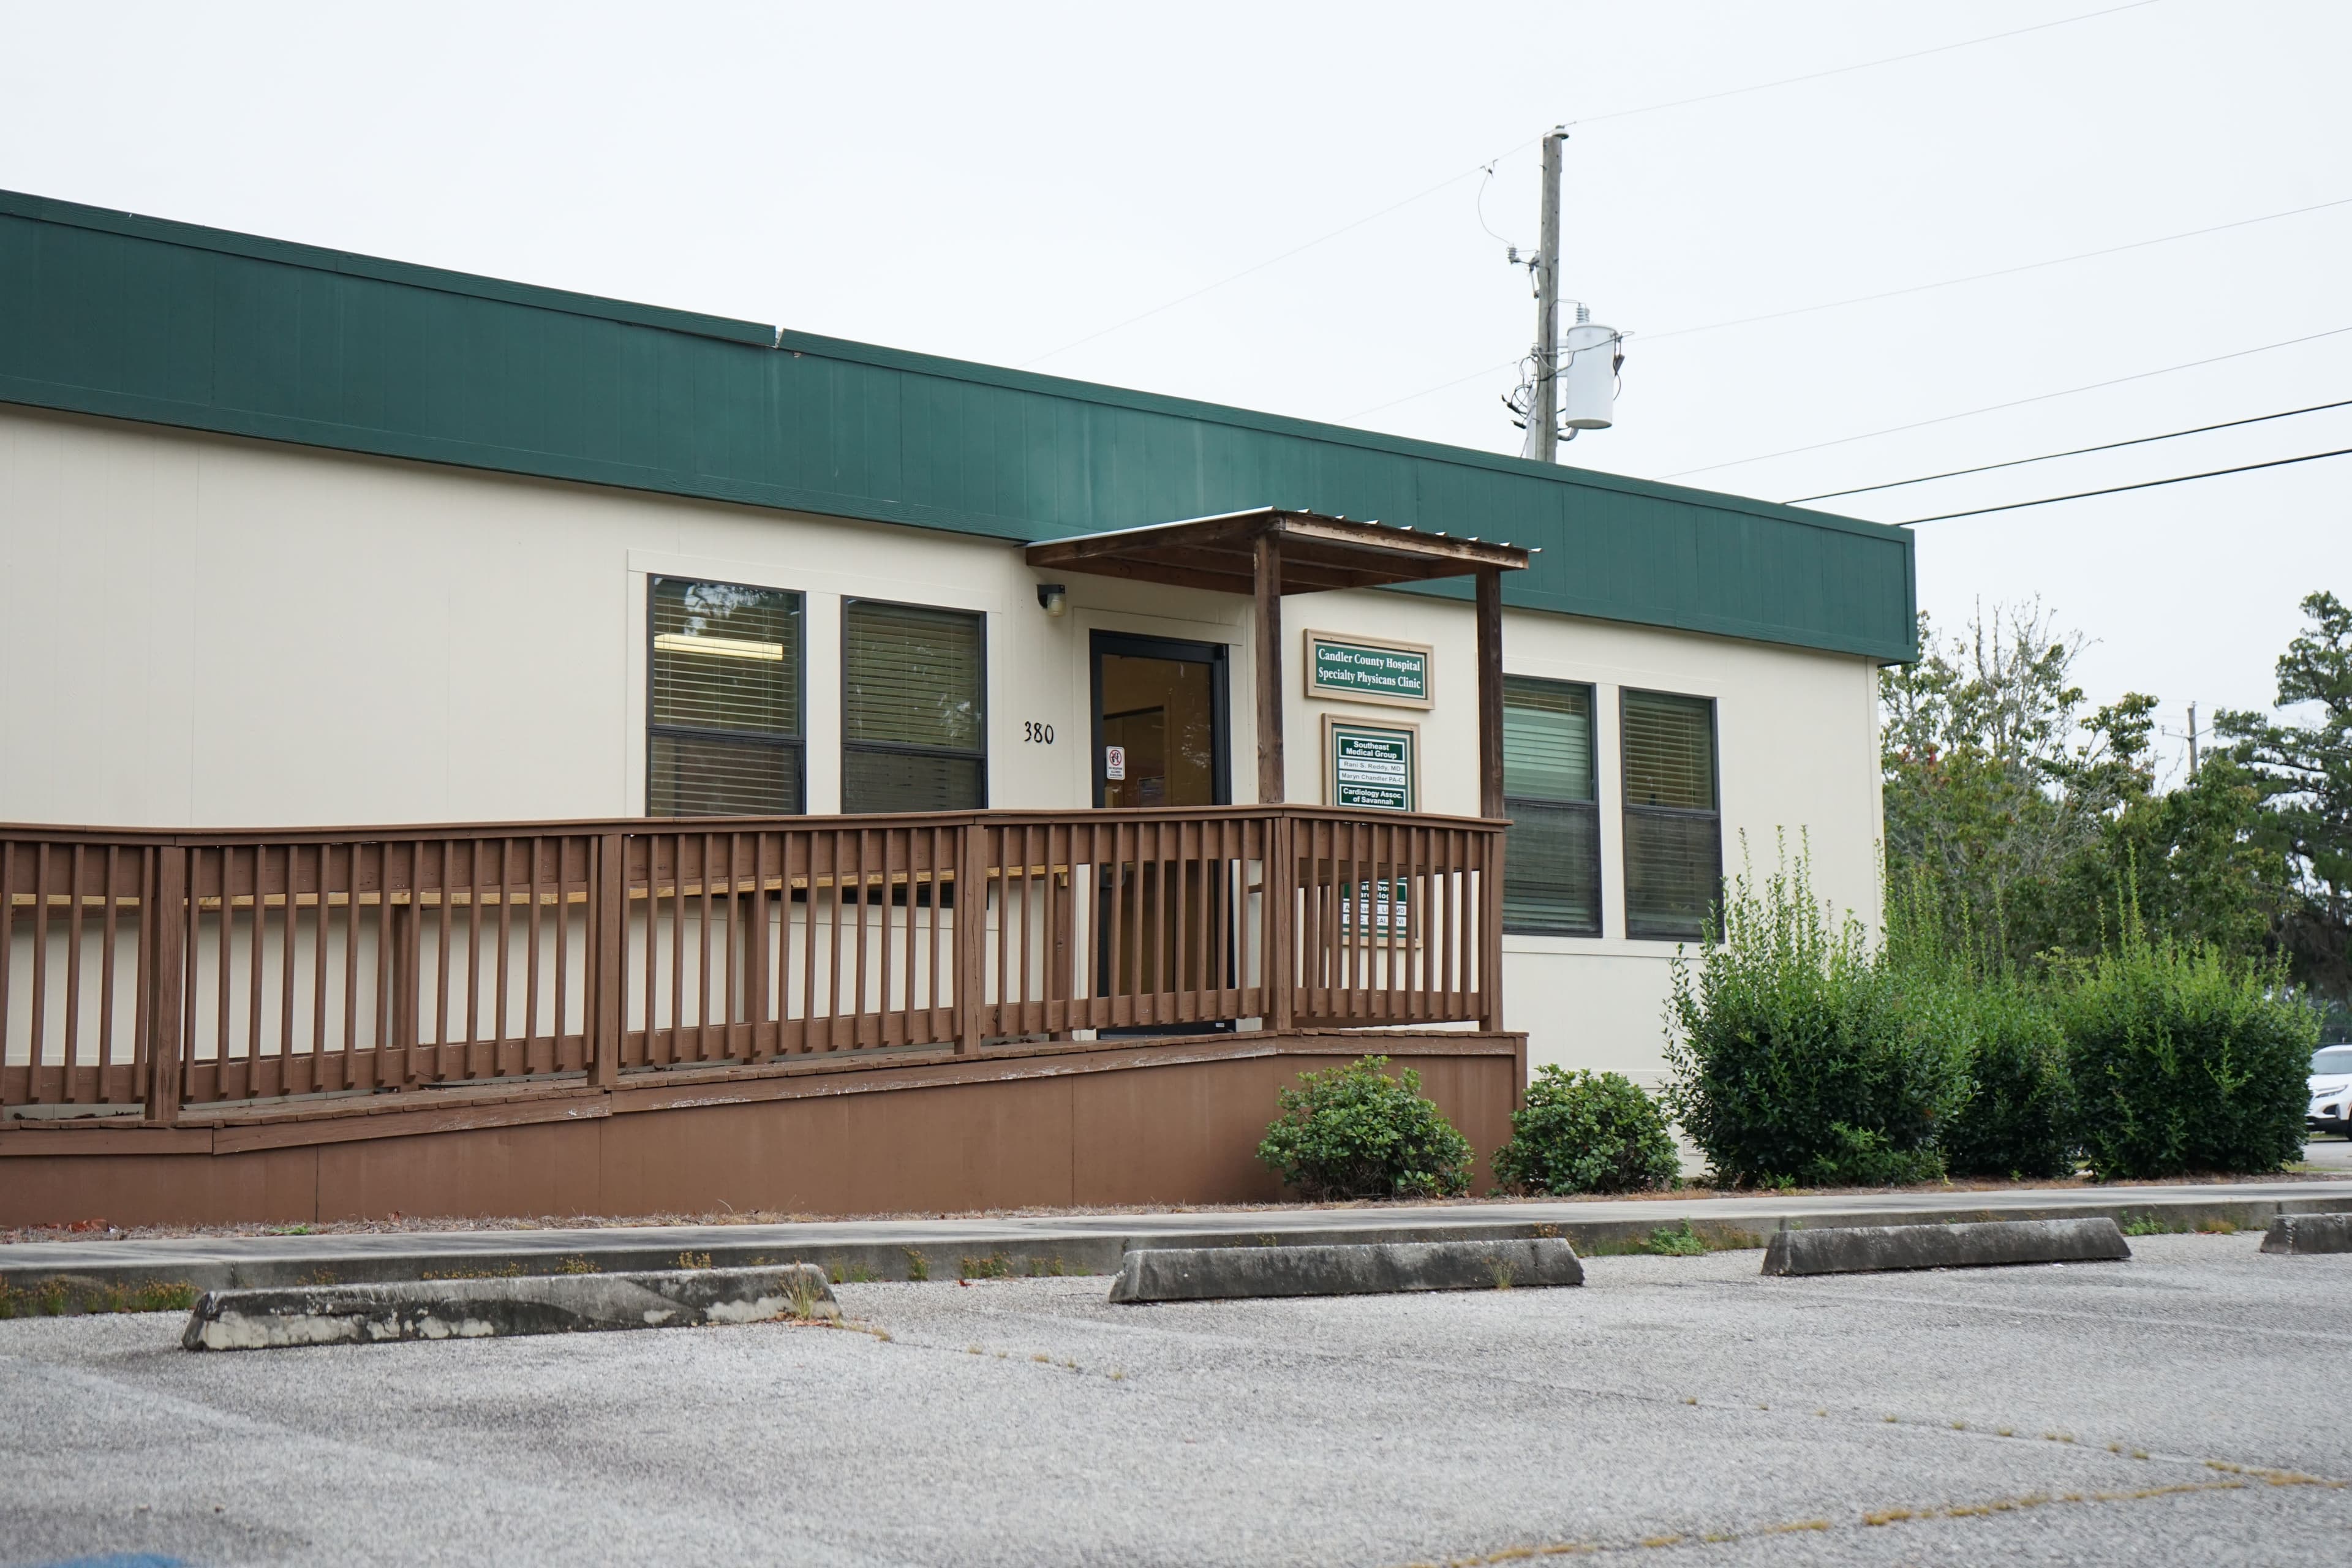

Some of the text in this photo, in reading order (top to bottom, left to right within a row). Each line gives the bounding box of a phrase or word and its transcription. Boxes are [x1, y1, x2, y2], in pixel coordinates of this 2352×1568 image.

[1318, 648, 1420, 673] Candler County Hospital
[1318, 666, 1421, 689] Specialty Physicans Clinic
[1024, 721, 1054, 744] 380
[1346, 748, 1396, 760] Medical Group
[1354, 741, 1389, 750] Southeast
[1343, 788, 1379, 797] Cardiology
